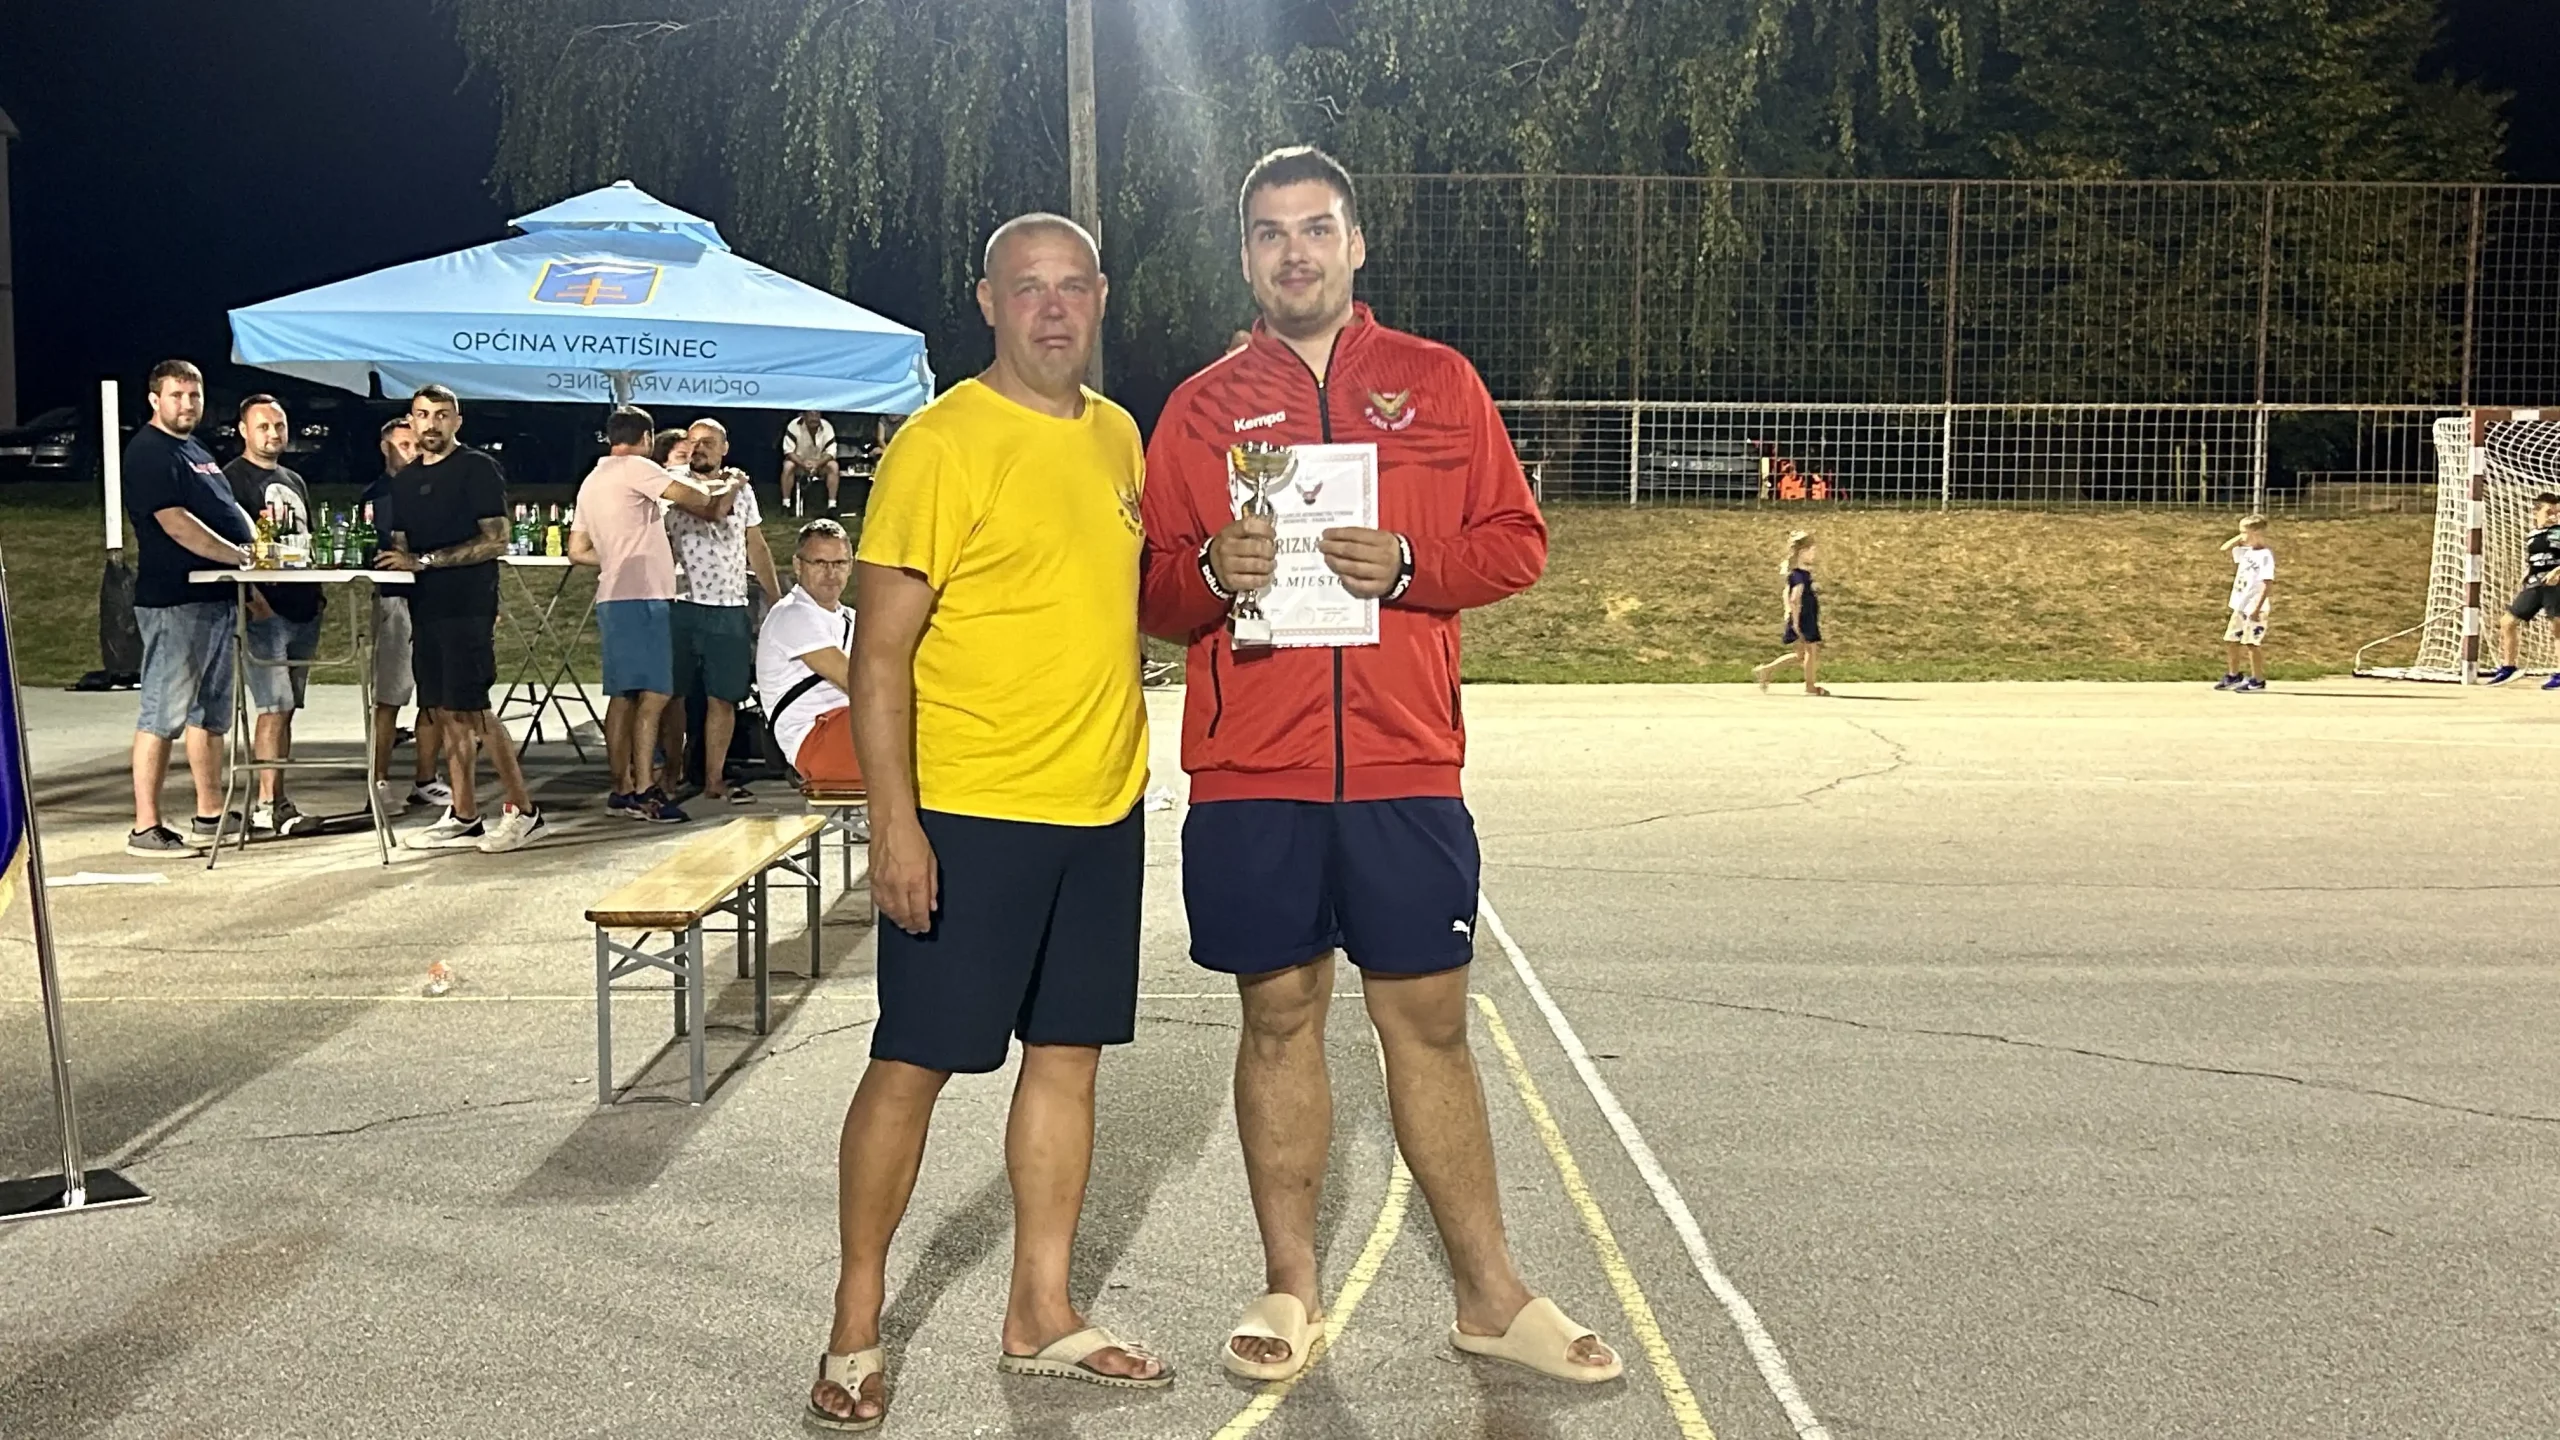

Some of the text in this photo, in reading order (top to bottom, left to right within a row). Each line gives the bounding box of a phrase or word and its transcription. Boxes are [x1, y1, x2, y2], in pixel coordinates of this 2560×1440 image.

[452, 328, 718, 358] OPĆINA VRATIŠINEC
[1233, 410, 1286, 433] Kempa
[1275, 536, 1321, 555] RIZNA
